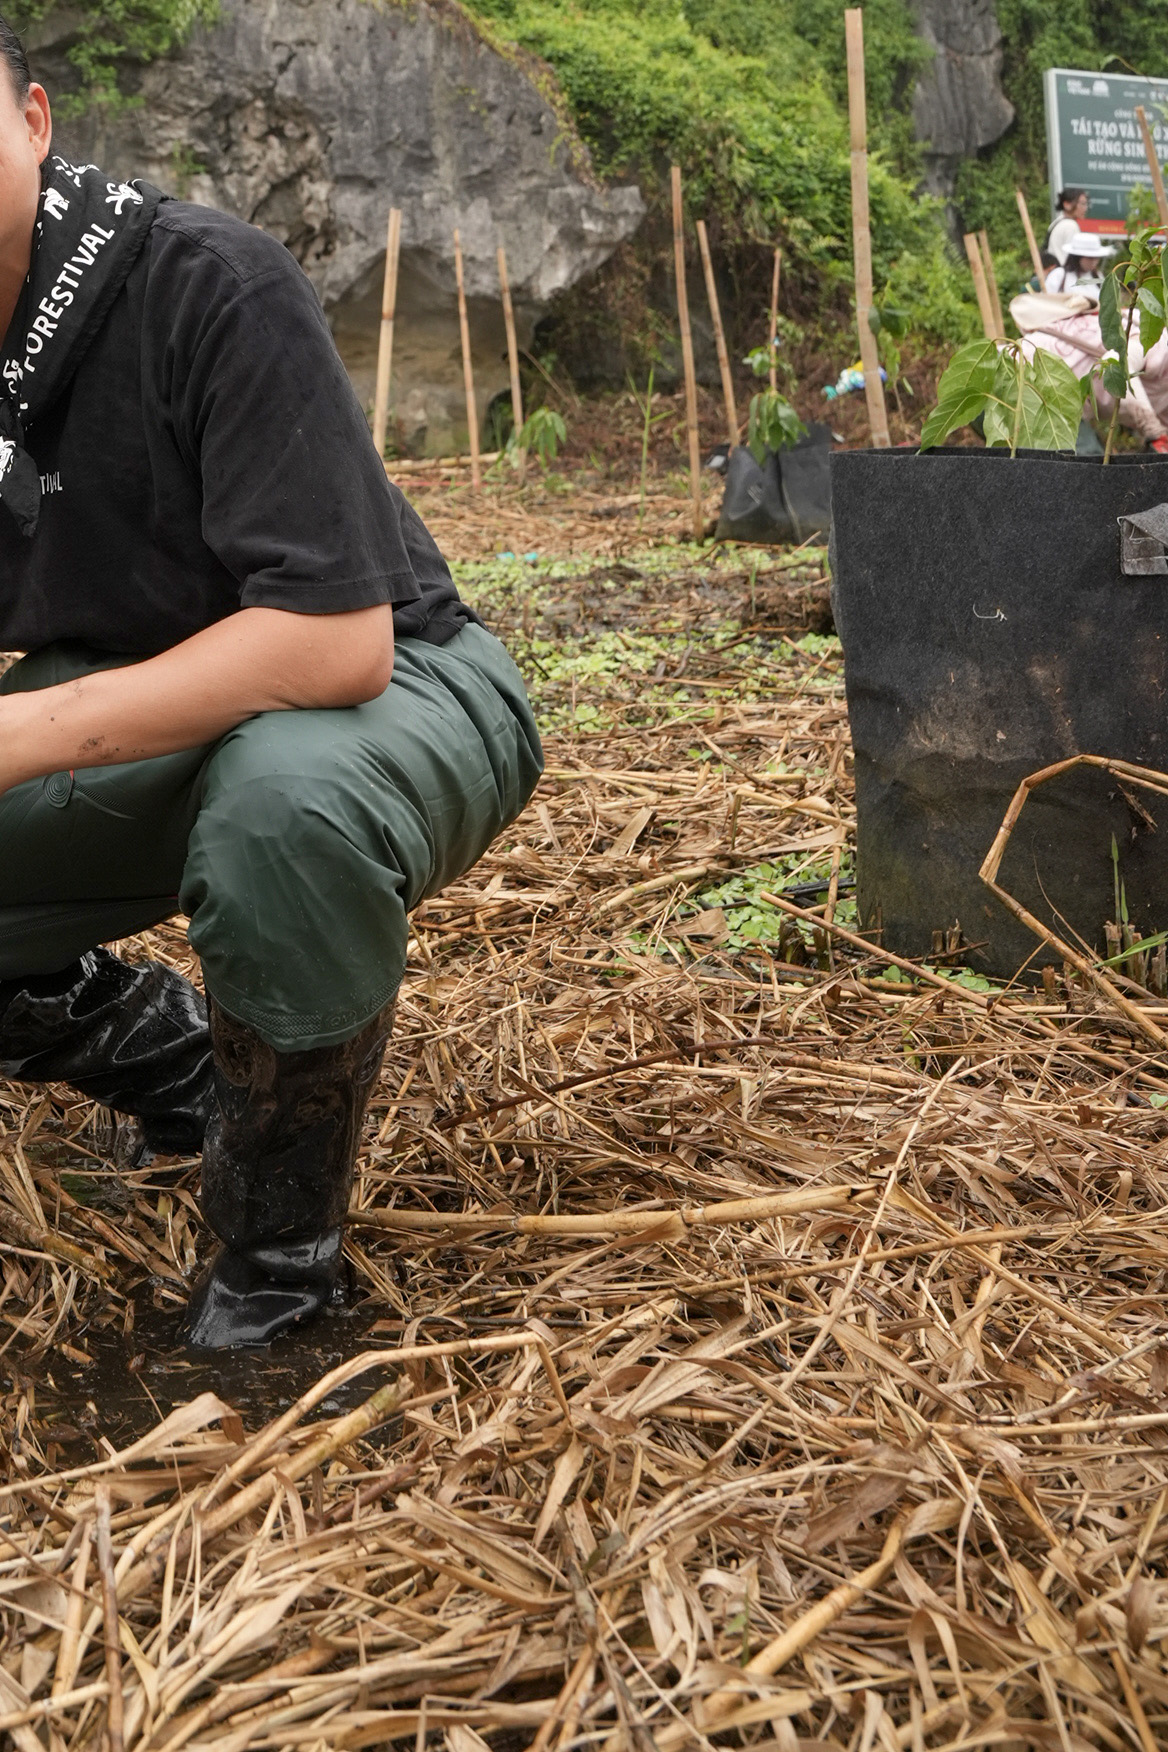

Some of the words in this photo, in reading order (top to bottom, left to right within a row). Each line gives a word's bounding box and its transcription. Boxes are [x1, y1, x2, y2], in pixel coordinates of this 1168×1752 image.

[1071, 116, 1092, 136] TÁI
[1093, 120, 1118, 139] TẠO
[1119, 120, 1136, 139] VÀ
[1123, 141, 1146, 159] SIN
